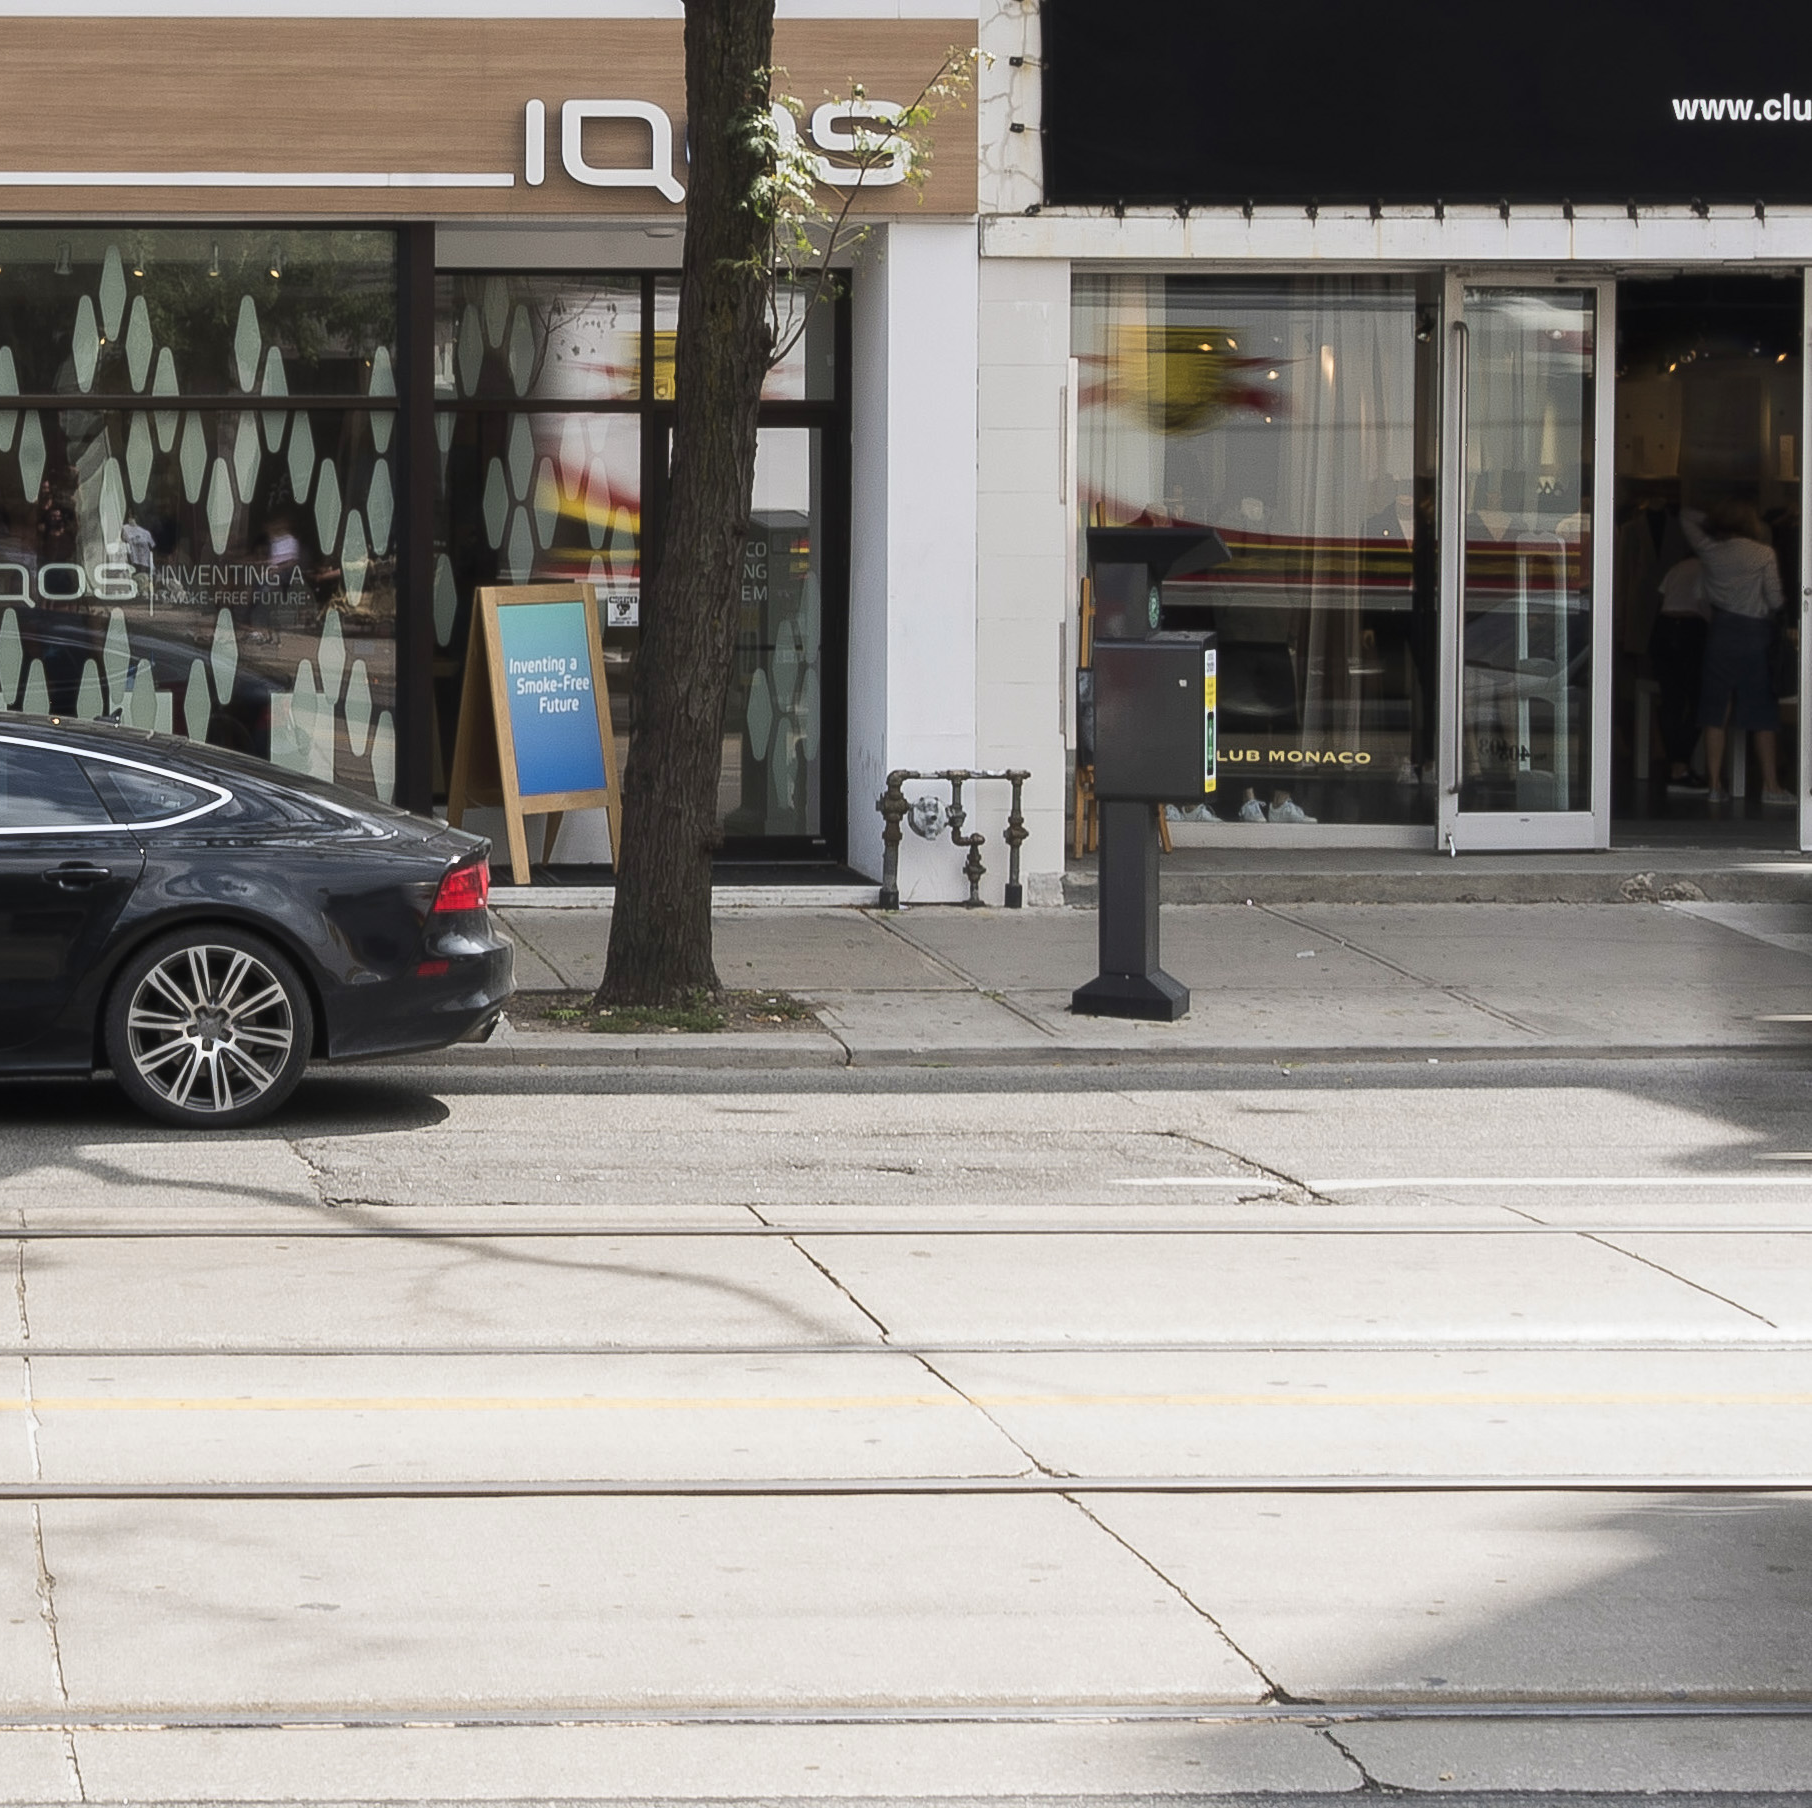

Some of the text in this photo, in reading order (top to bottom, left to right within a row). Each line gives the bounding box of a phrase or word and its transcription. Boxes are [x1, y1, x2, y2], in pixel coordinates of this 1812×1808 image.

[161, 563, 305, 586] INVENTING A
[509, 655, 578, 676] Inventing a
[516, 674, 590, 695] Smoke-Free
[539, 696, 580, 714] Future
[1216, 749, 1371, 765] LUB MONACO
